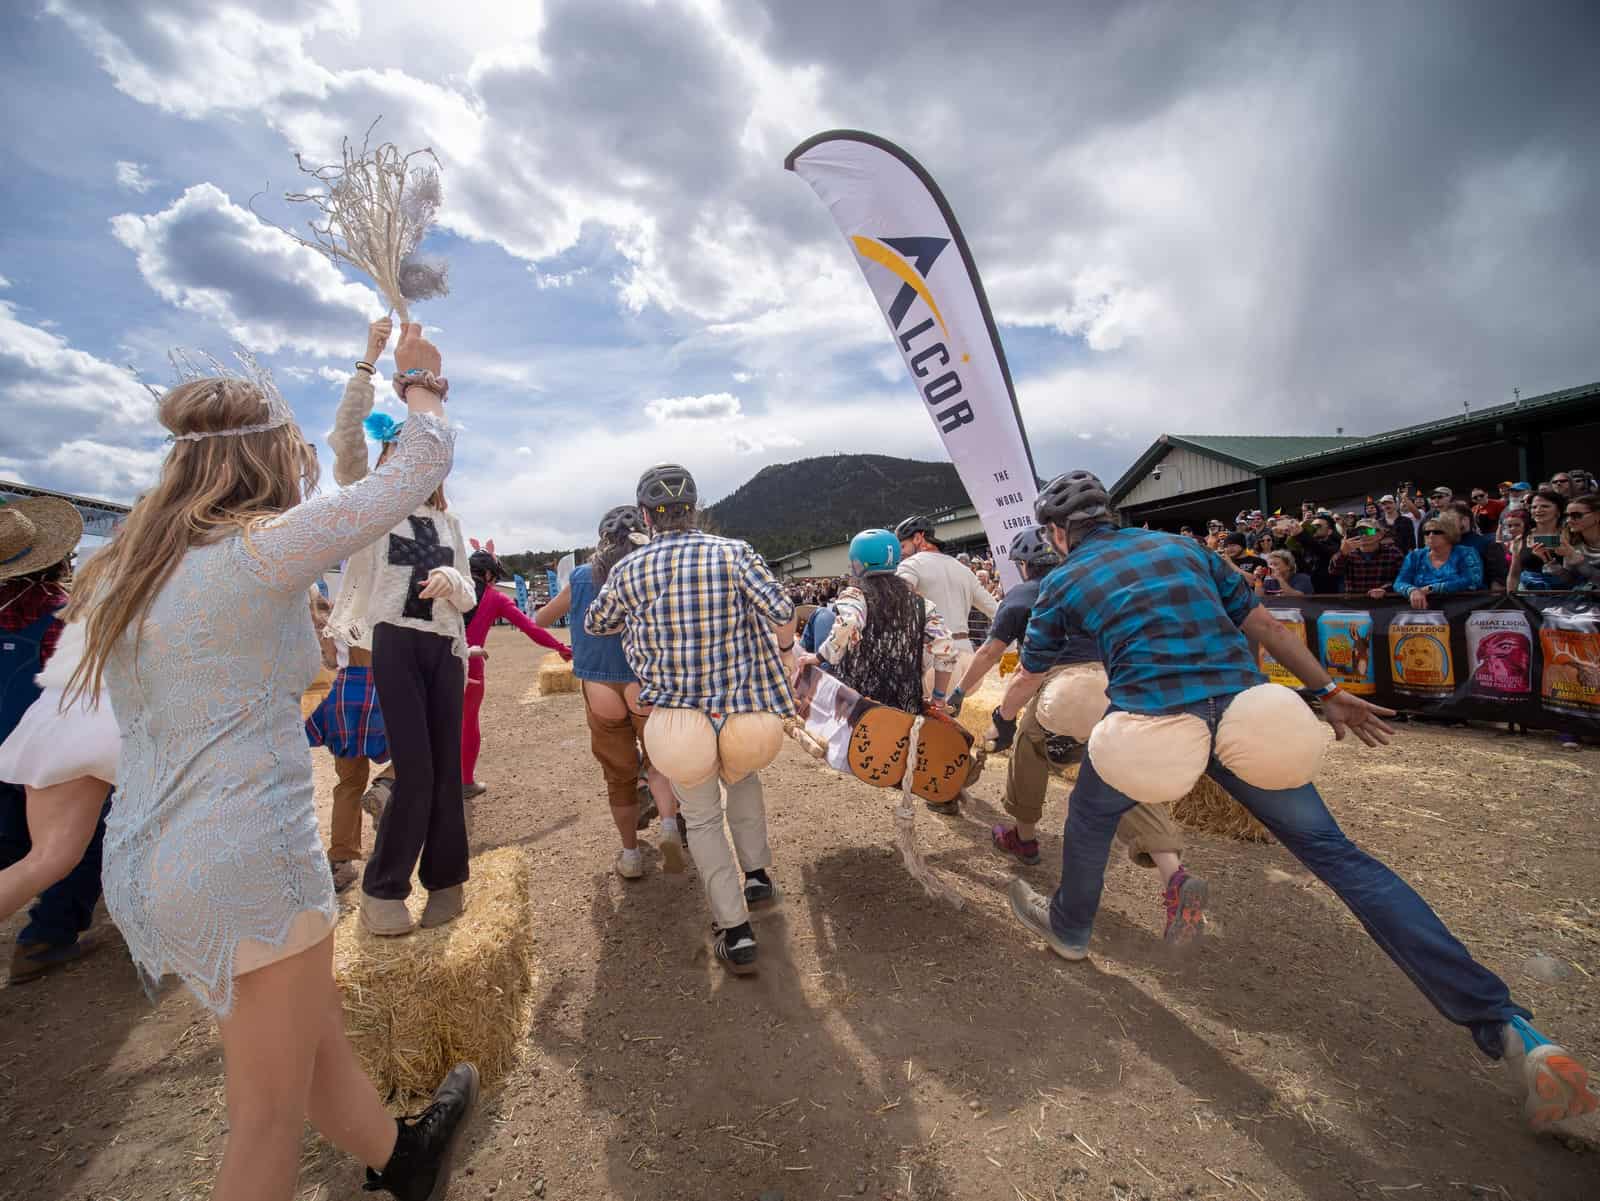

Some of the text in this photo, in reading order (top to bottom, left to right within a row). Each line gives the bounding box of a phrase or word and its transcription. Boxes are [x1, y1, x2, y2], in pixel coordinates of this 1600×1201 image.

[877, 236, 975, 434] ALCOR
[993, 470, 1009, 483] THE
[995, 492, 1023, 507] WORLD
[1003, 515, 1032, 530] LEADER
